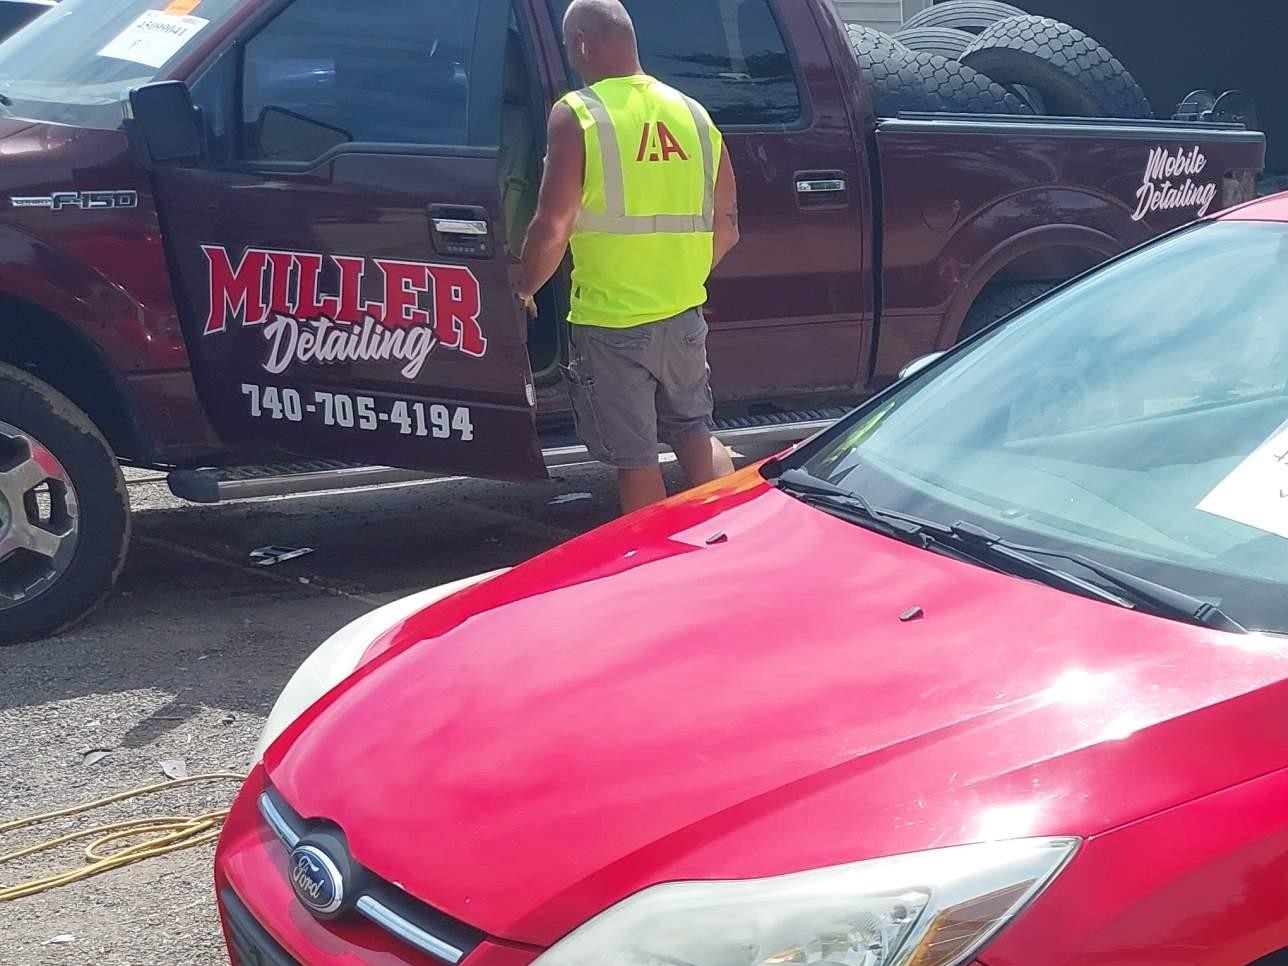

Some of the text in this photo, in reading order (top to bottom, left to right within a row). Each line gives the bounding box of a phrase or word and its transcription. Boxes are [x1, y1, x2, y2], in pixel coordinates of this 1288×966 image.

[1143, 146, 1207, 184] Mobile
[51, 190, 138, 210] F-150
[1131, 178, 1217, 221] Detailing
[200, 245, 488, 358] MILLER
[262, 314, 438, 379] Detailing
[241, 383, 475, 441] 740-705-4194
[293, 855, 325, 899] Ford
